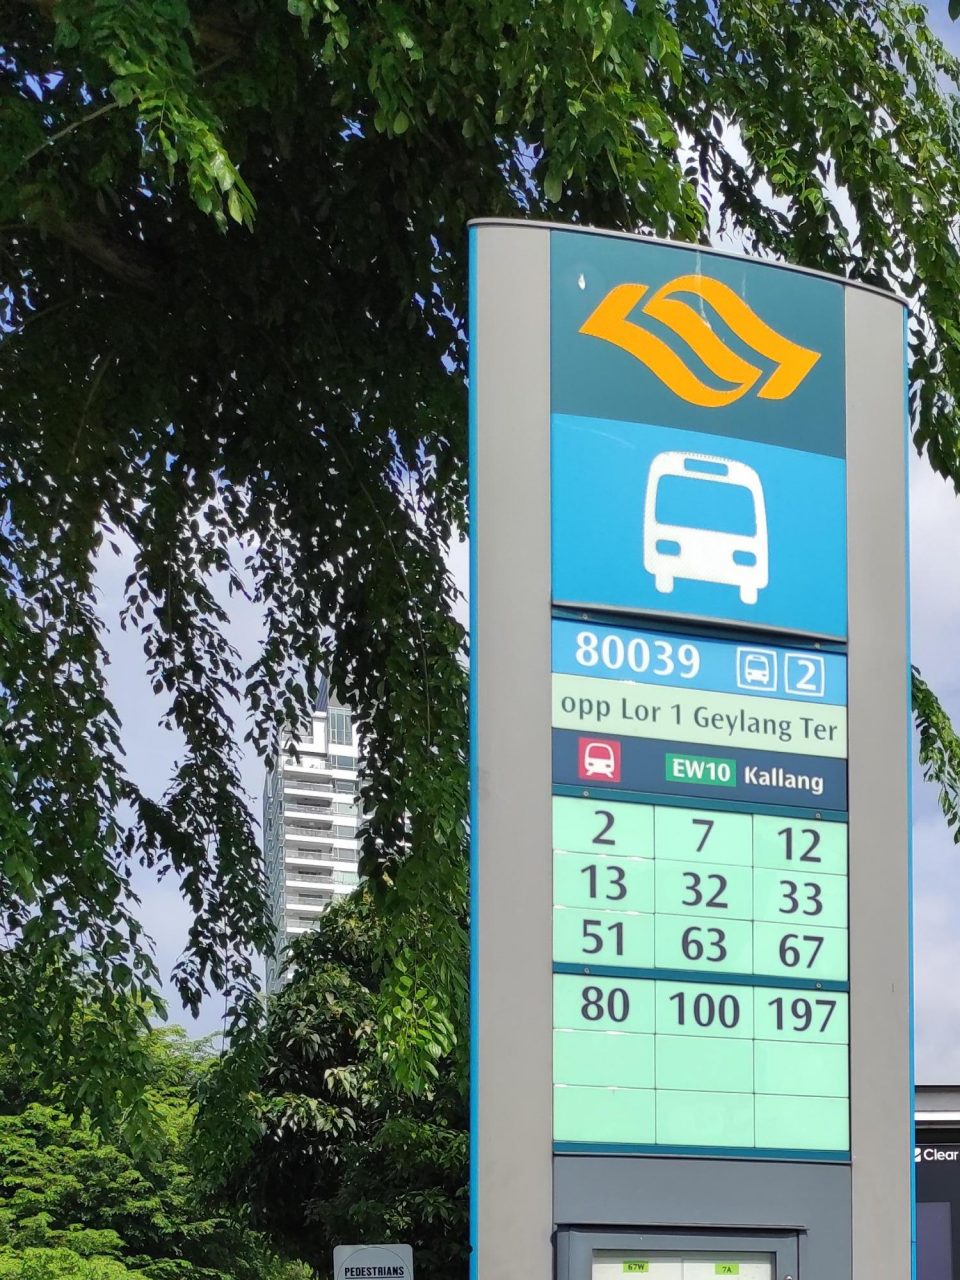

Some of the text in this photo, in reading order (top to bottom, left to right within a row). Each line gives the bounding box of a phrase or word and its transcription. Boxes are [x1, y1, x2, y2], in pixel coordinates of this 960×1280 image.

[575, 631, 817, 691] 80039 2
[561, 695, 838, 742] opp Lor 1 Geylang Ter
[672, 758, 824, 795] EW10 Kallang
[592, 810, 821, 863] 2 7 12
[580, 864, 823, 916] 13 32 33
[581, 919, 824, 969] 51 63 67
[580, 986, 837, 1033] 80 100 197
[923, 1148, 959, 1160] Clear
[344, 1266, 405, 1276] PEDESTRIANS
[627, 1263, 645, 1271] 67W
